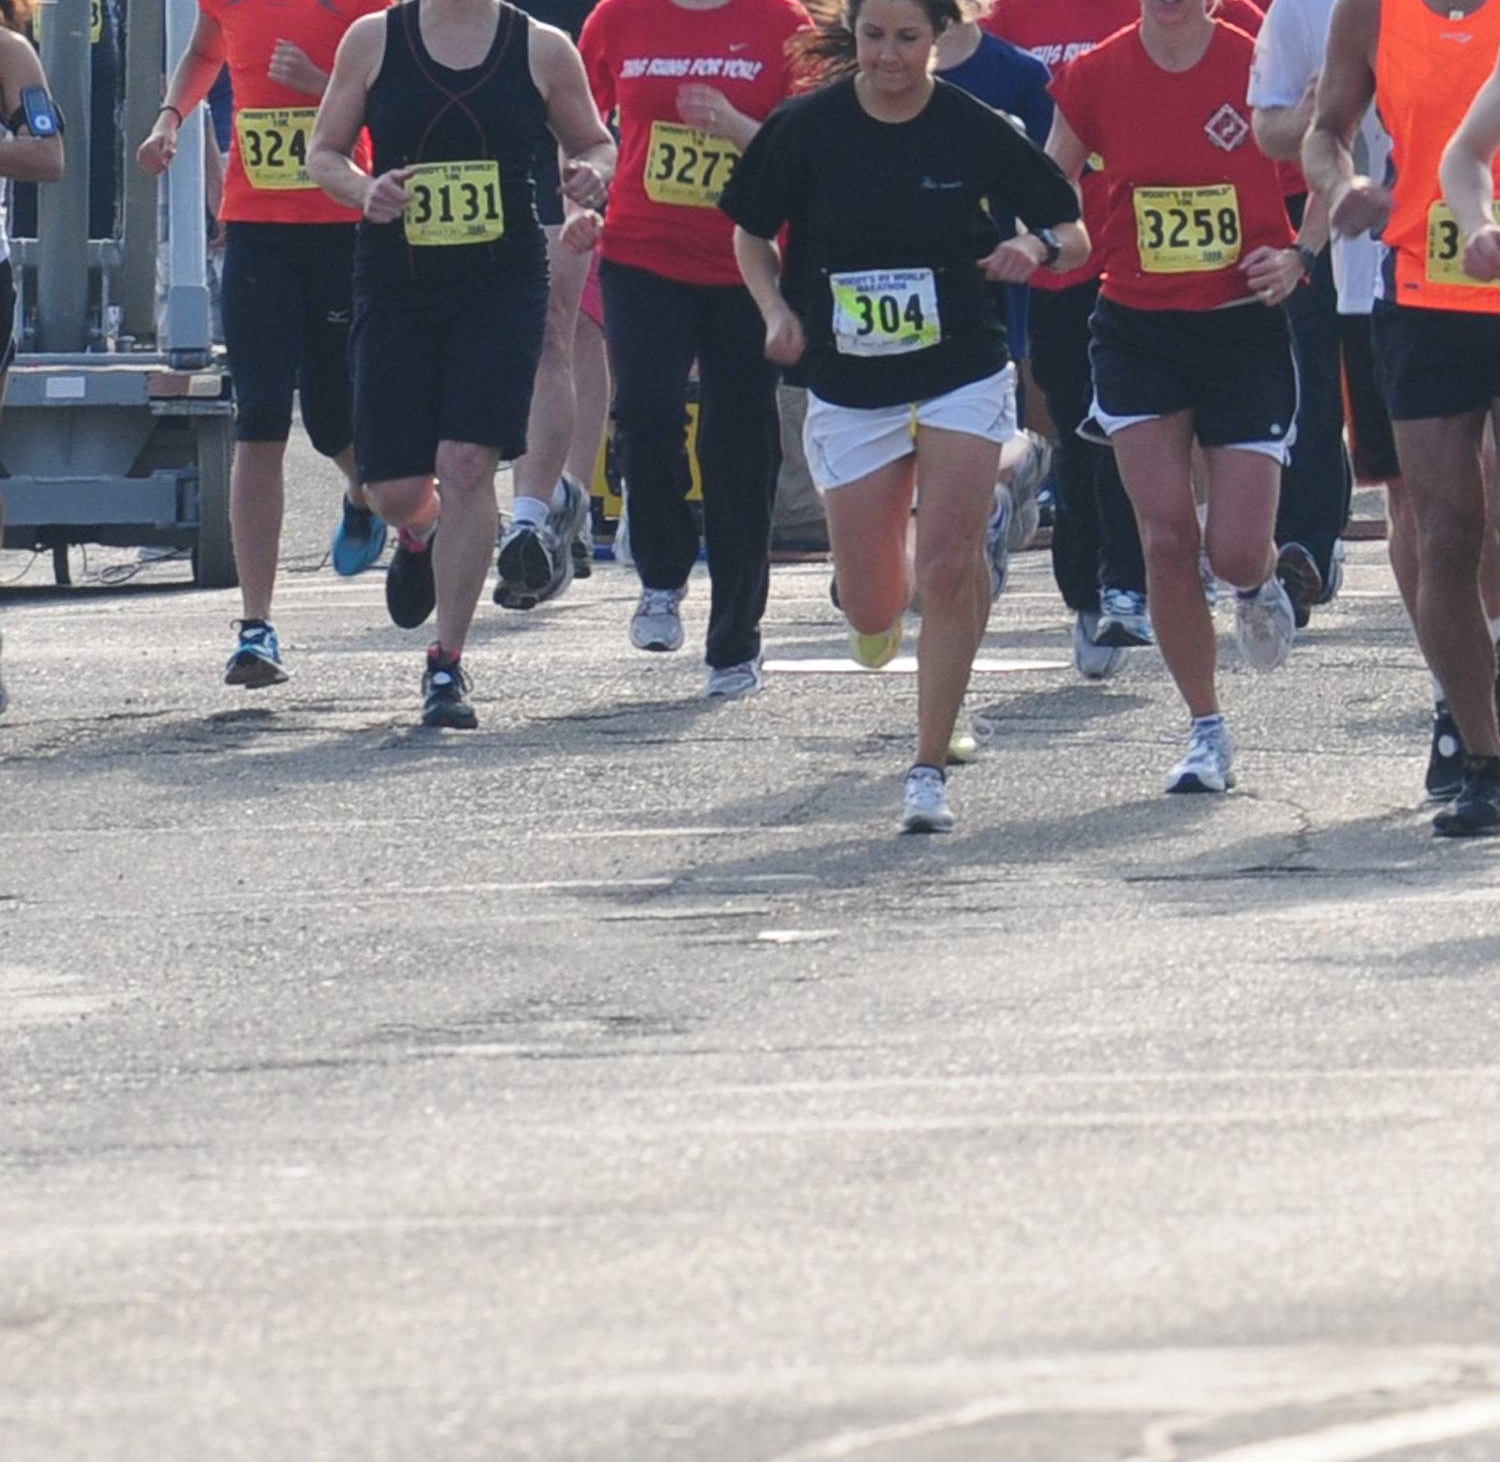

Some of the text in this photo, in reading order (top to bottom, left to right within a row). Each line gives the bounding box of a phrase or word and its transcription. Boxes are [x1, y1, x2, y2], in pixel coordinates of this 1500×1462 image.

[689, 58, 723, 77] FOR
[722, 58, 762, 80] YOU!
[414, 183, 499, 223] 3131
[1144, 207, 1239, 248] 3258
[855, 293, 925, 336] 304
